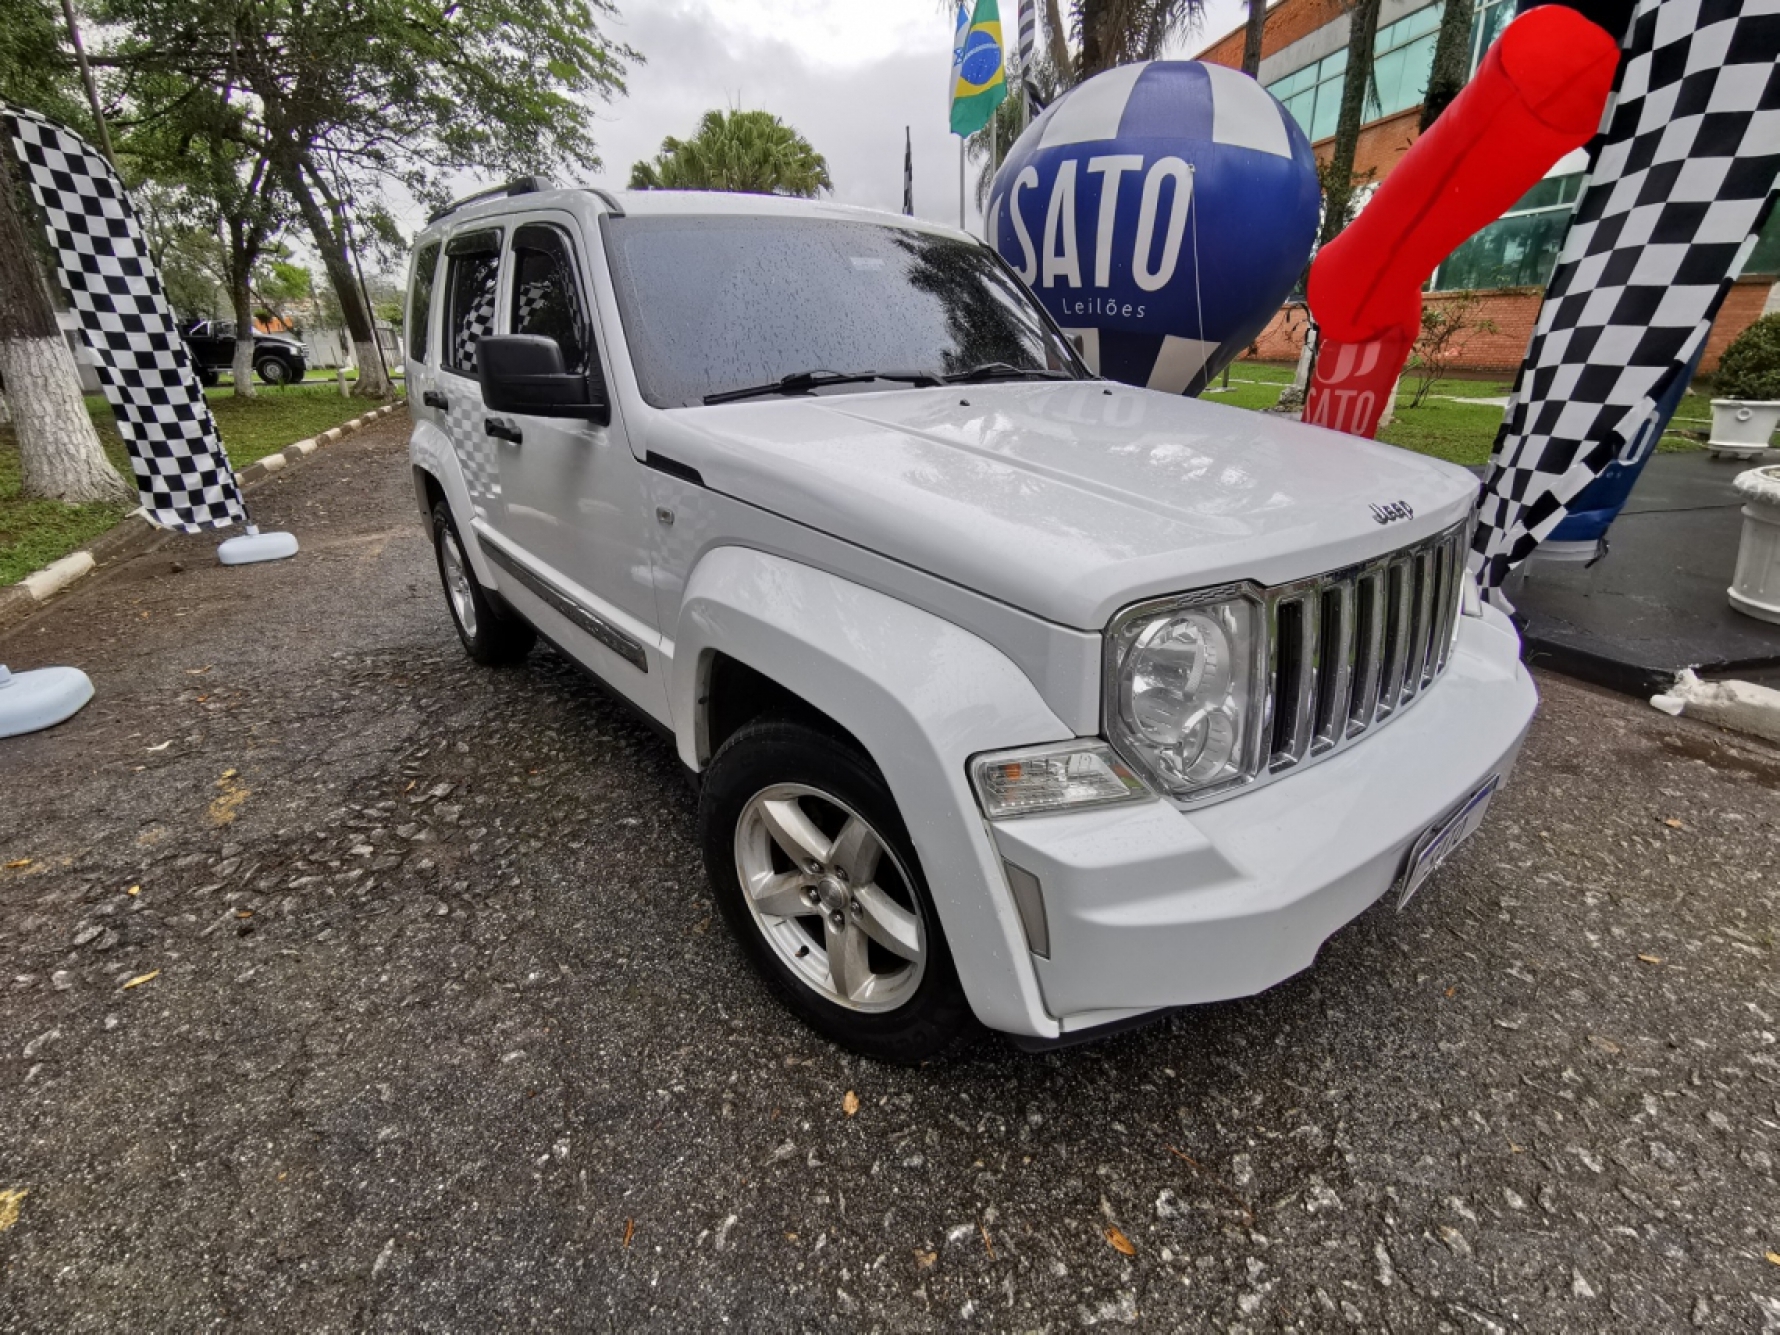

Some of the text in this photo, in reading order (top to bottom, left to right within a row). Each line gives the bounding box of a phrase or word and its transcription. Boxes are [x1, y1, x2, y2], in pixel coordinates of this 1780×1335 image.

[1010, 155, 1194, 292] SATO
[1062, 298, 1146, 318] Leilões
[1368, 500, 1414, 525] Jeep
